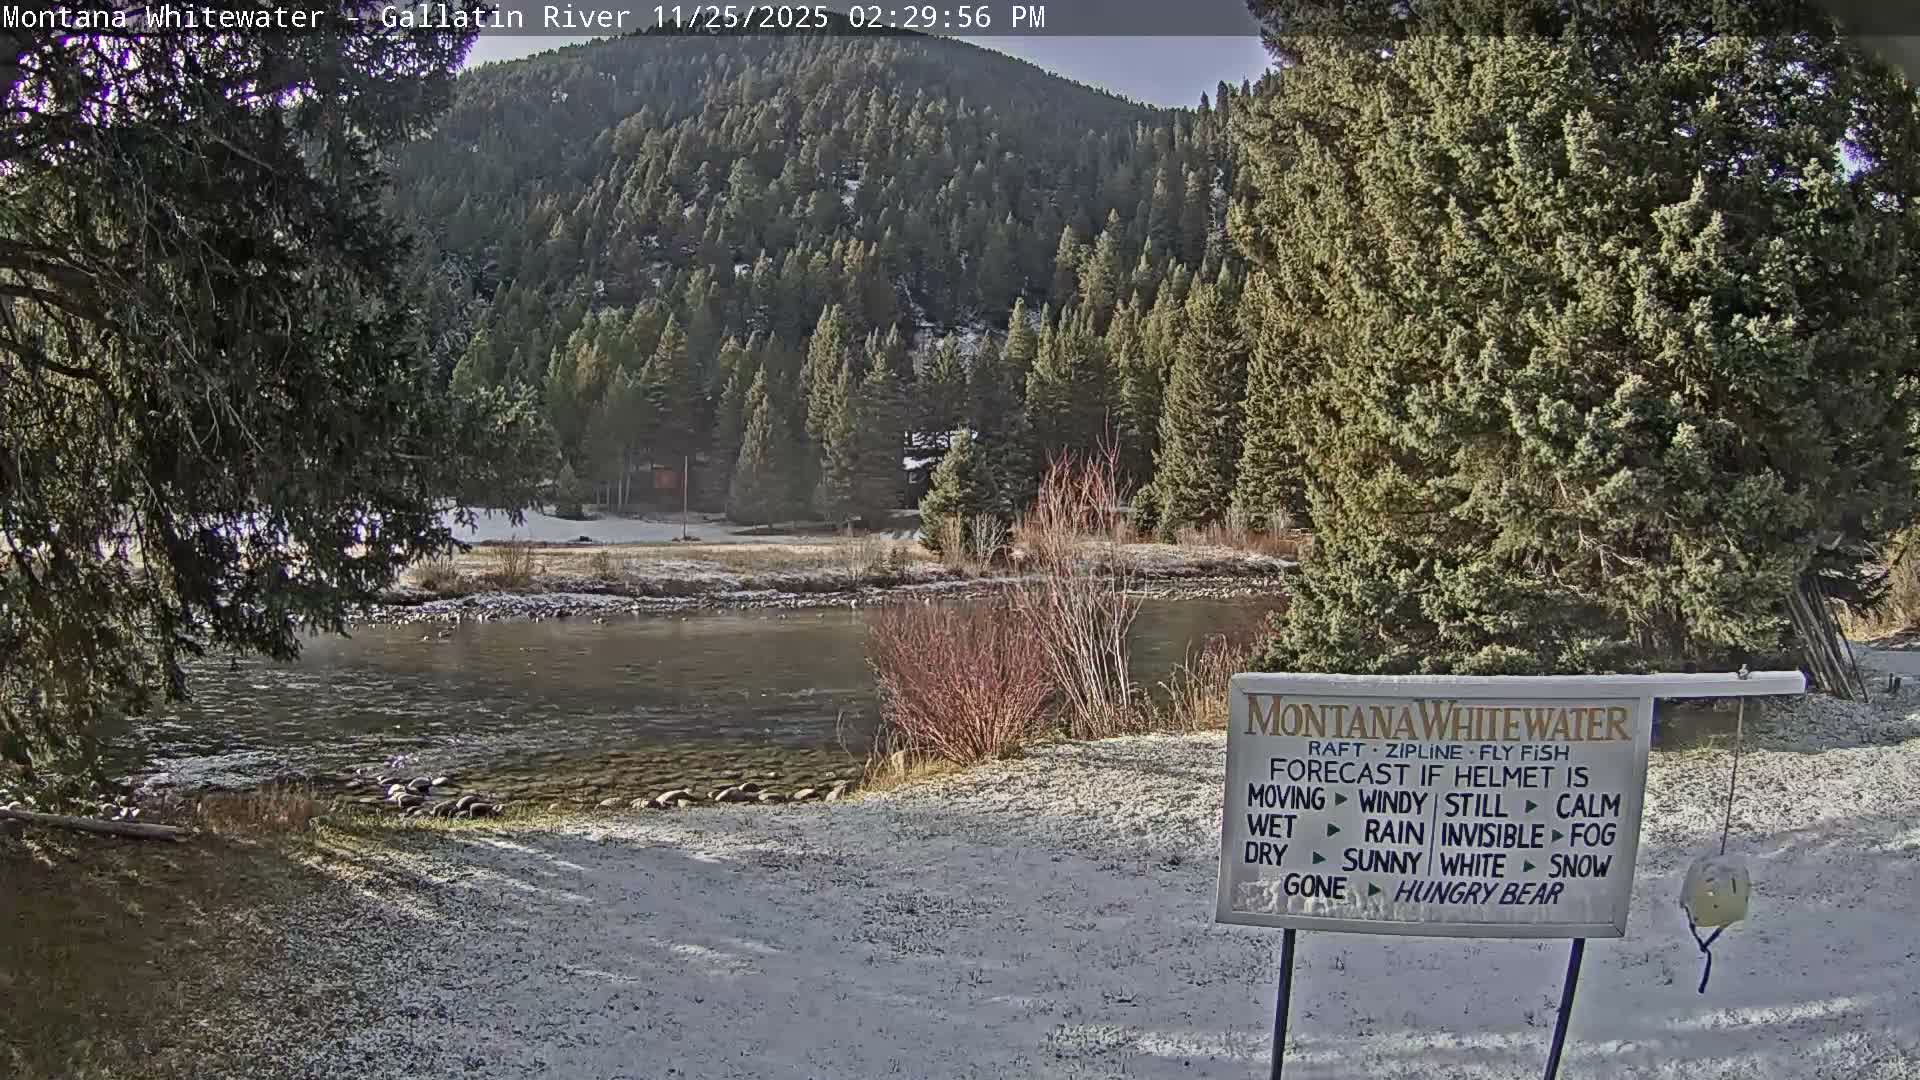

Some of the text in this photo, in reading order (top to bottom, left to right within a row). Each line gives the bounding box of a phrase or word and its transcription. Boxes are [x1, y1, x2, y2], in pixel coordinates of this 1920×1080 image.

[1308, 741, 1367, 757] RAFT
[1479, 744, 1514, 761] FLY
[1270, 758, 1589, 788] FORECAST IF HELMET IS
[1247, 784, 1428, 815] MOVING WINDY
[1444, 792, 1621, 819] STILL CALM
[1247, 813, 1425, 845] WET RAIN
[1441, 822, 1617, 848] INVISIBLE FOG
[1244, 841, 1423, 875] DRY SUNNY
[1440, 852, 1612, 878] WHITE SNOW
[1284, 872, 1564, 905] GONE HUNGRY BEAR
